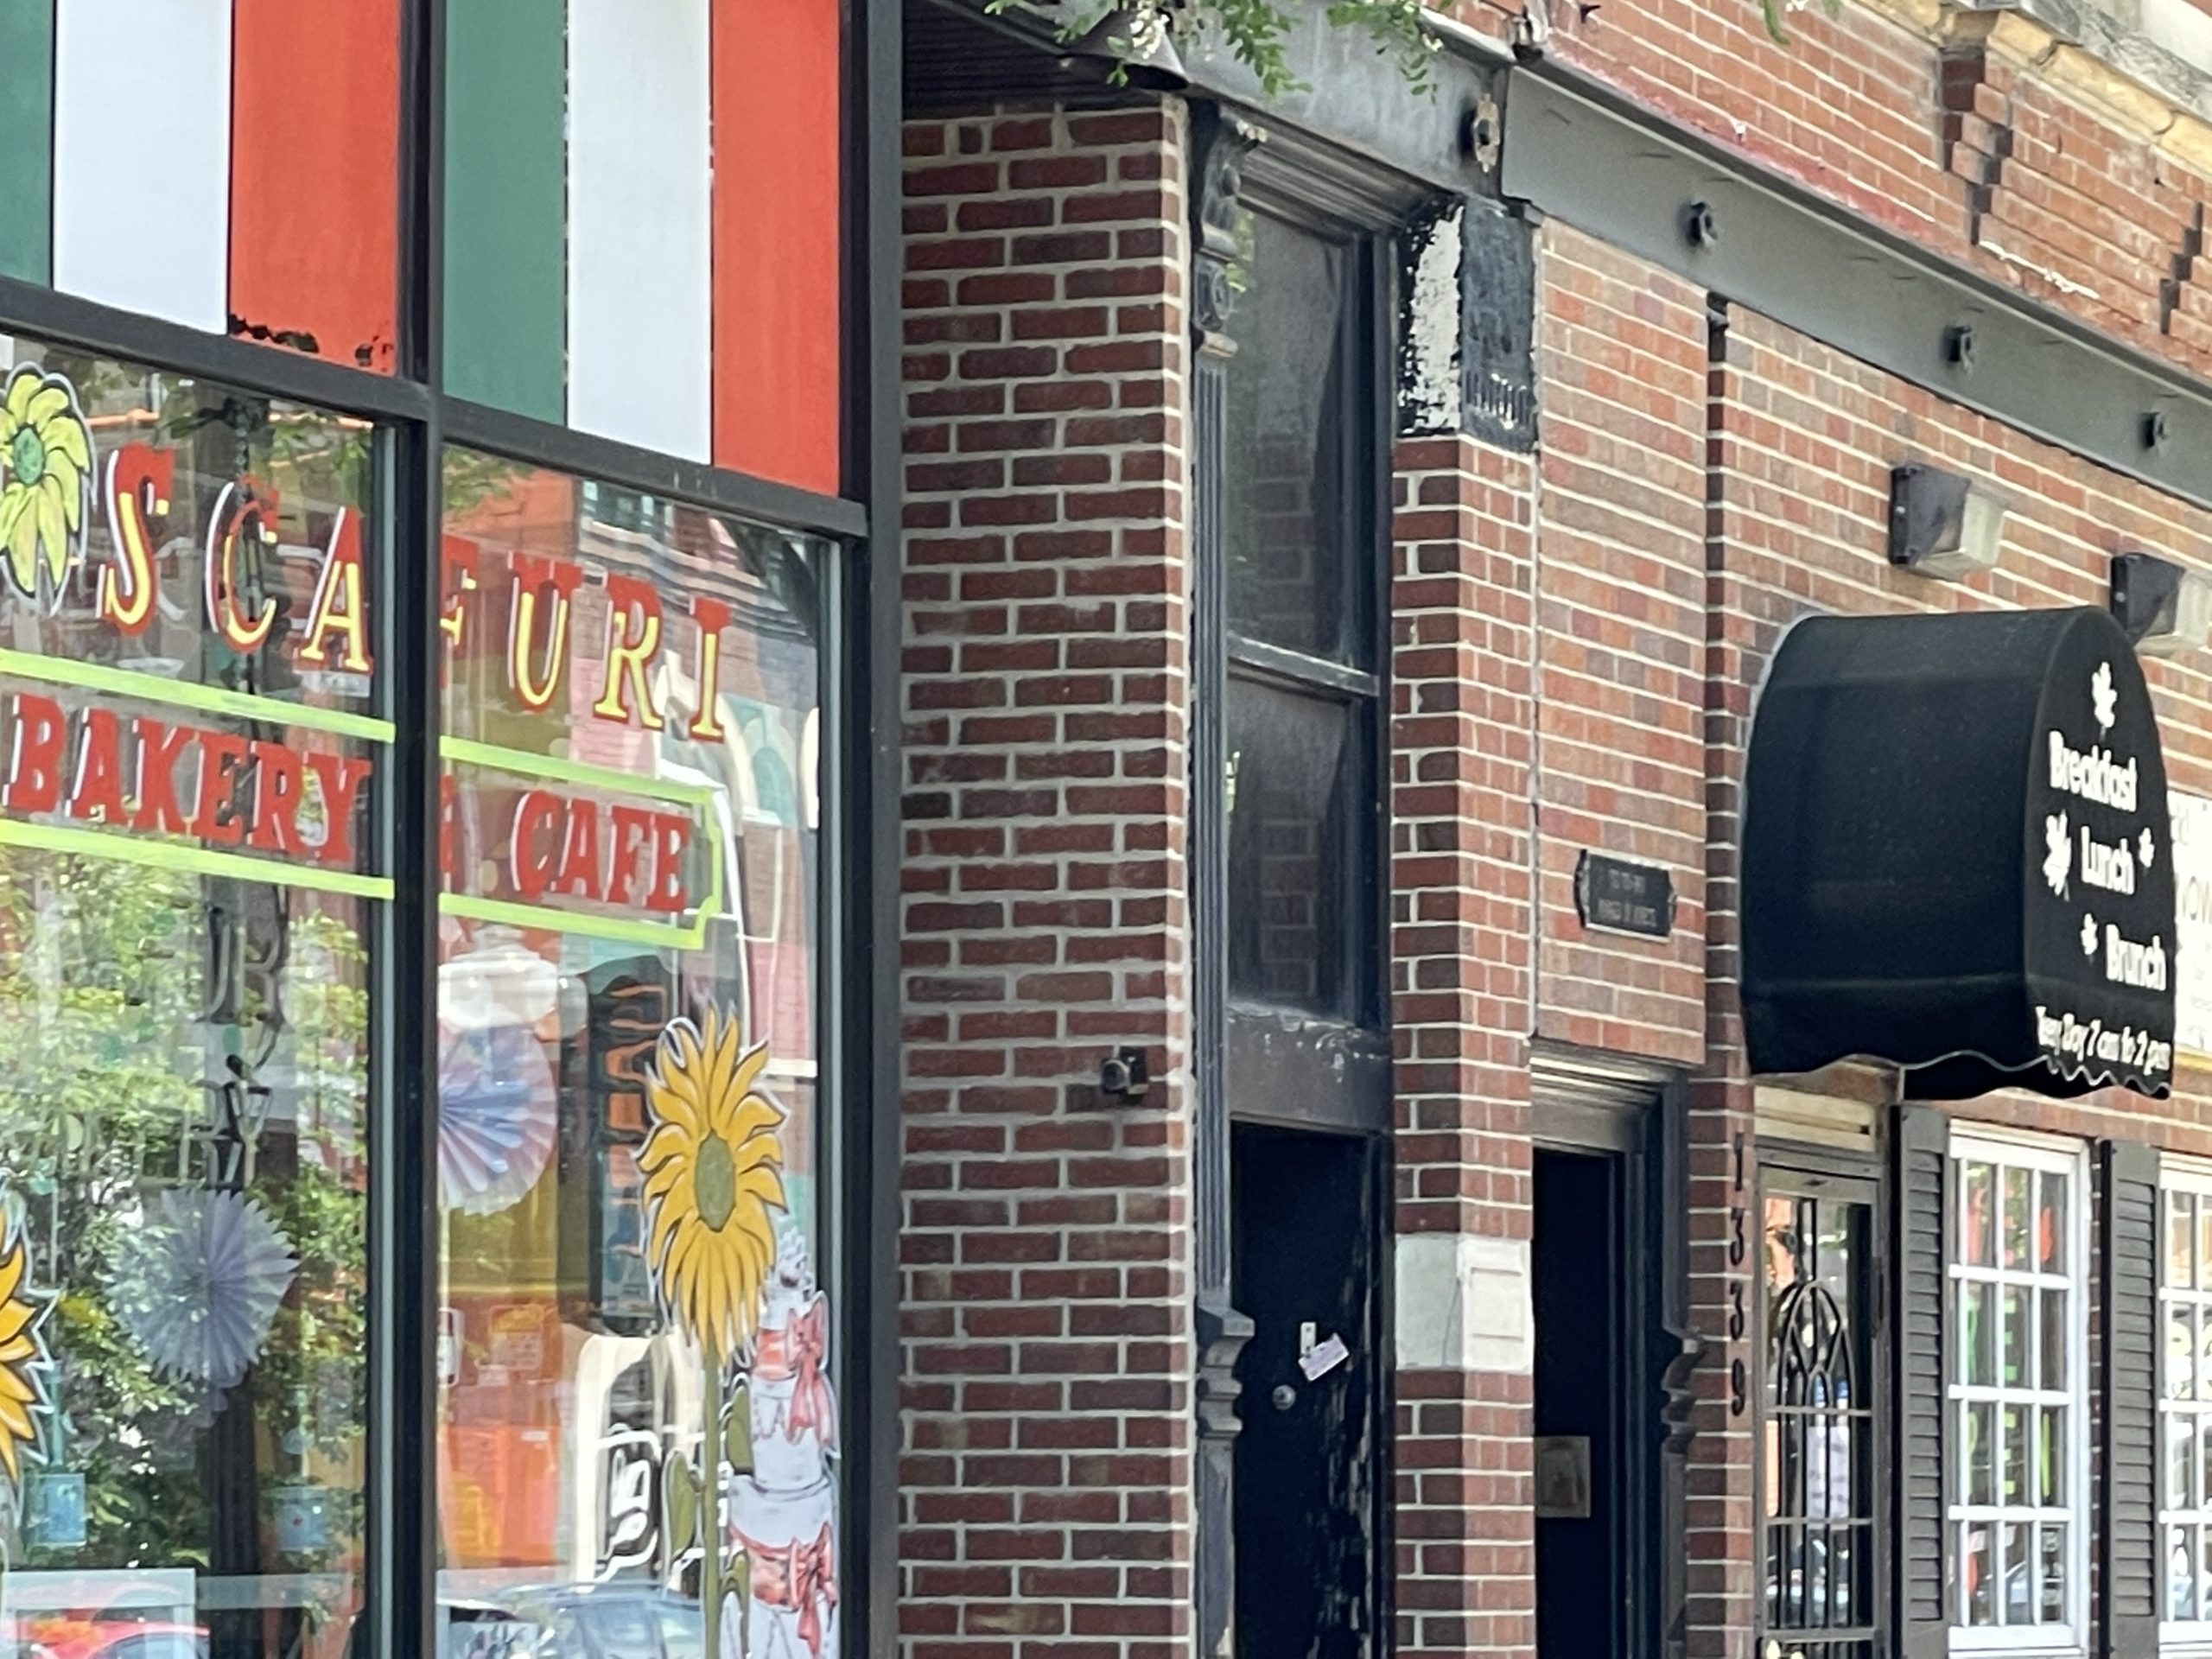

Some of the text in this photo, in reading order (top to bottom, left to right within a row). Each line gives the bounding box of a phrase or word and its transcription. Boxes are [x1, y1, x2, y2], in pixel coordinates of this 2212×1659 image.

[3, 694, 372, 862] BAKERY
[510, 789, 692, 912] CAFE
[2049, 730, 2138, 812] Breakfast
[2081, 825, 2135, 894] Lunch
[2106, 924, 2166, 991] Brunch
